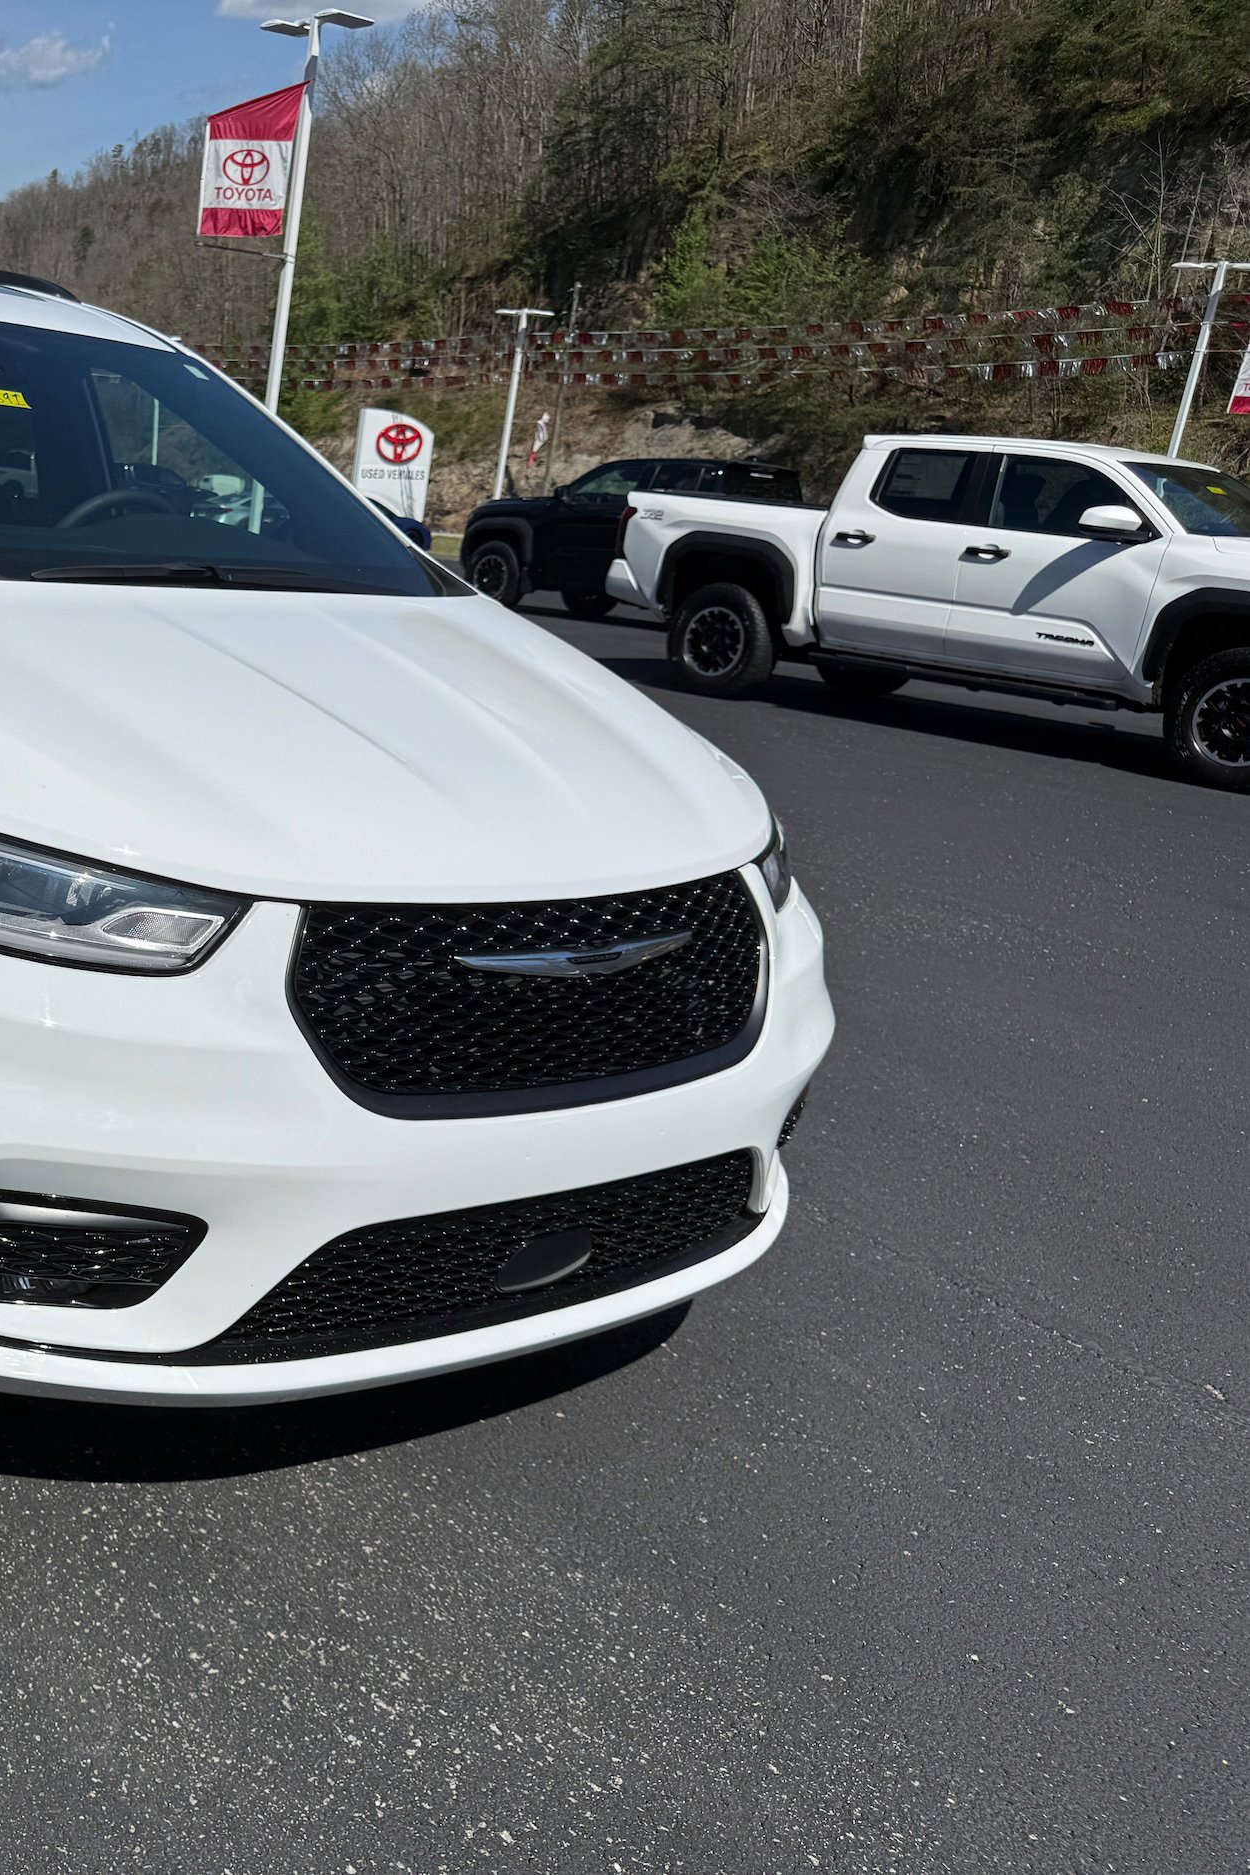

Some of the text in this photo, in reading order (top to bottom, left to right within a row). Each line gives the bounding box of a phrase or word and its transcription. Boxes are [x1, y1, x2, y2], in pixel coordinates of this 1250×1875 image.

[214, 187, 273, 202] TOYOTA
[361, 468, 385, 479] USED
[1036, 632, 1095, 647] TACOMA
